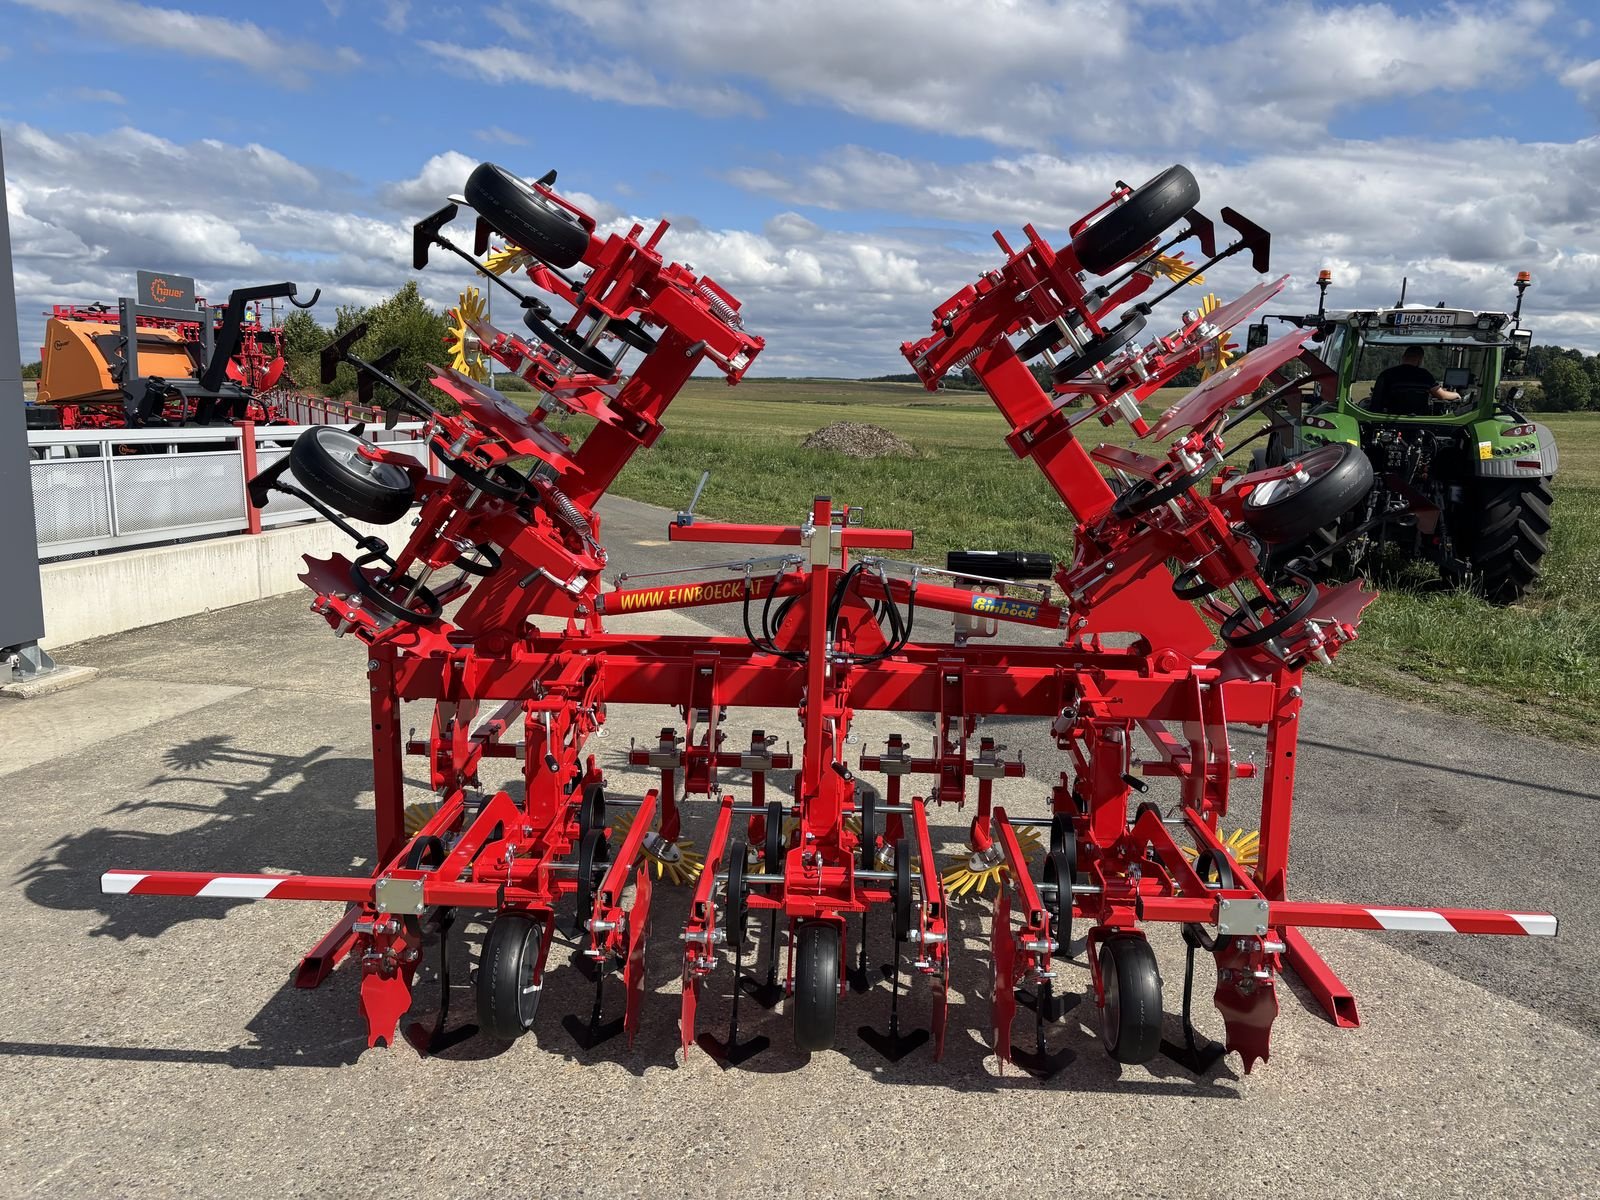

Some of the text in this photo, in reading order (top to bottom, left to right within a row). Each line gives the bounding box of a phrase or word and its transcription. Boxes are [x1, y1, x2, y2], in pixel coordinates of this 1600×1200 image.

[156, 284, 184, 297] hauer
[1404, 314, 1451, 325] HO 741CT
[973, 597, 1037, 619] Einböck
